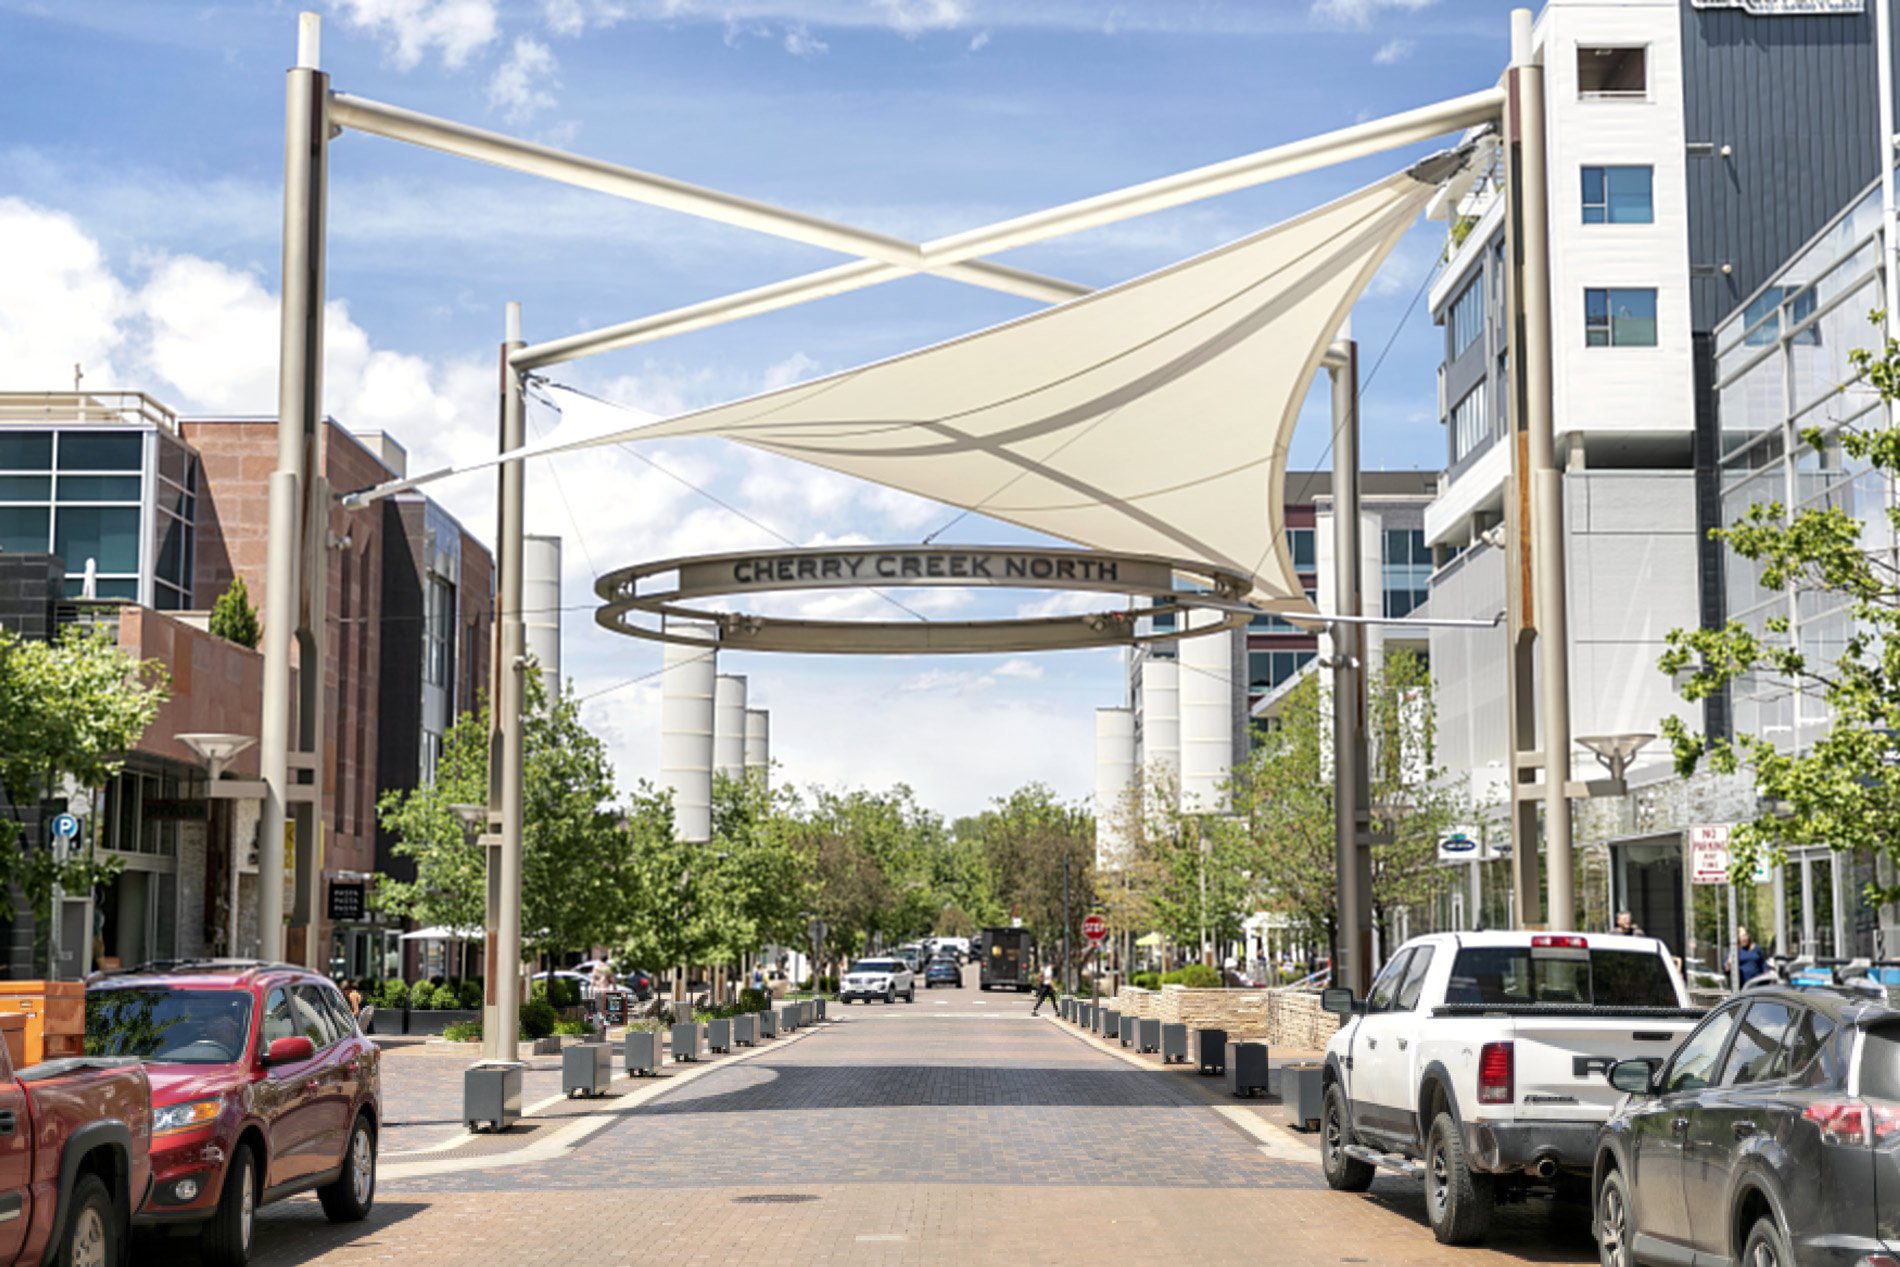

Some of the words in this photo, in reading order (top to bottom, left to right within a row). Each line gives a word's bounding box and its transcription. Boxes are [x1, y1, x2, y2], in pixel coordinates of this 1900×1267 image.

[733, 556, 864, 583] CHERRY
[876, 555, 992, 577] CREEK
[1005, 557, 1118, 581] NORTH
[60, 818, 73, 835] P
[1702, 828, 1717, 839] NO
[1693, 841, 1726, 852] PARKING
[1084, 922, 1105, 932] STOP
